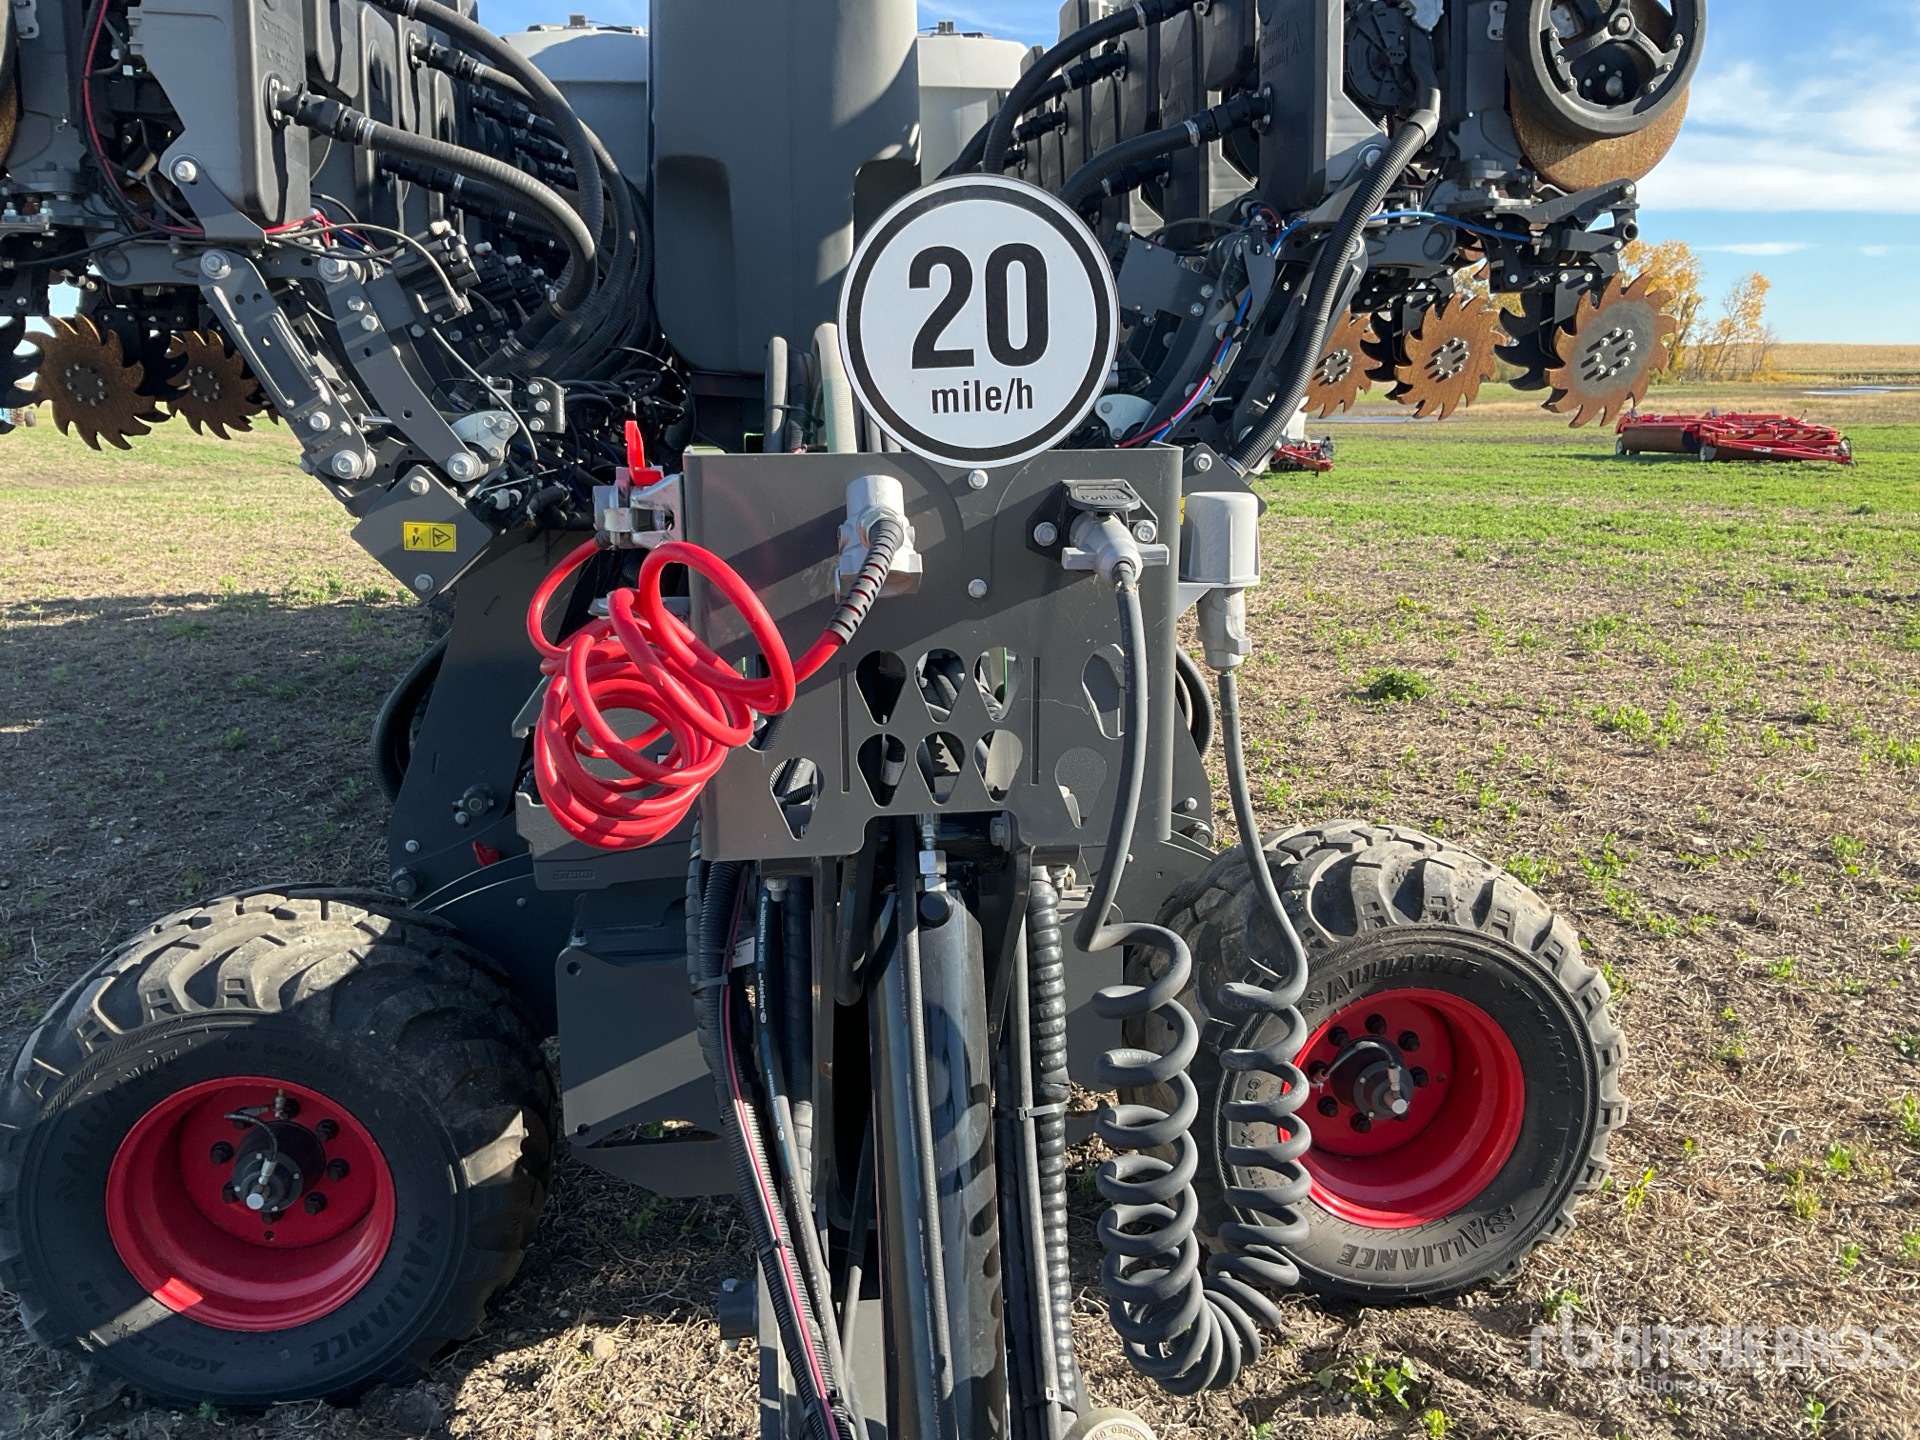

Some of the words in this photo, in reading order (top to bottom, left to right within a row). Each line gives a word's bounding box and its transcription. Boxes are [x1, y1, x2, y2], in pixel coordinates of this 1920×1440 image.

[908, 242, 1049, 369] 20
[931, 377, 1033, 415] mile/h
[1326, 953, 1482, 1006] ALLIANCE
[1336, 1215, 1489, 1272] ALLIANCE
[311, 1239, 433, 1367] ALLIANCE
